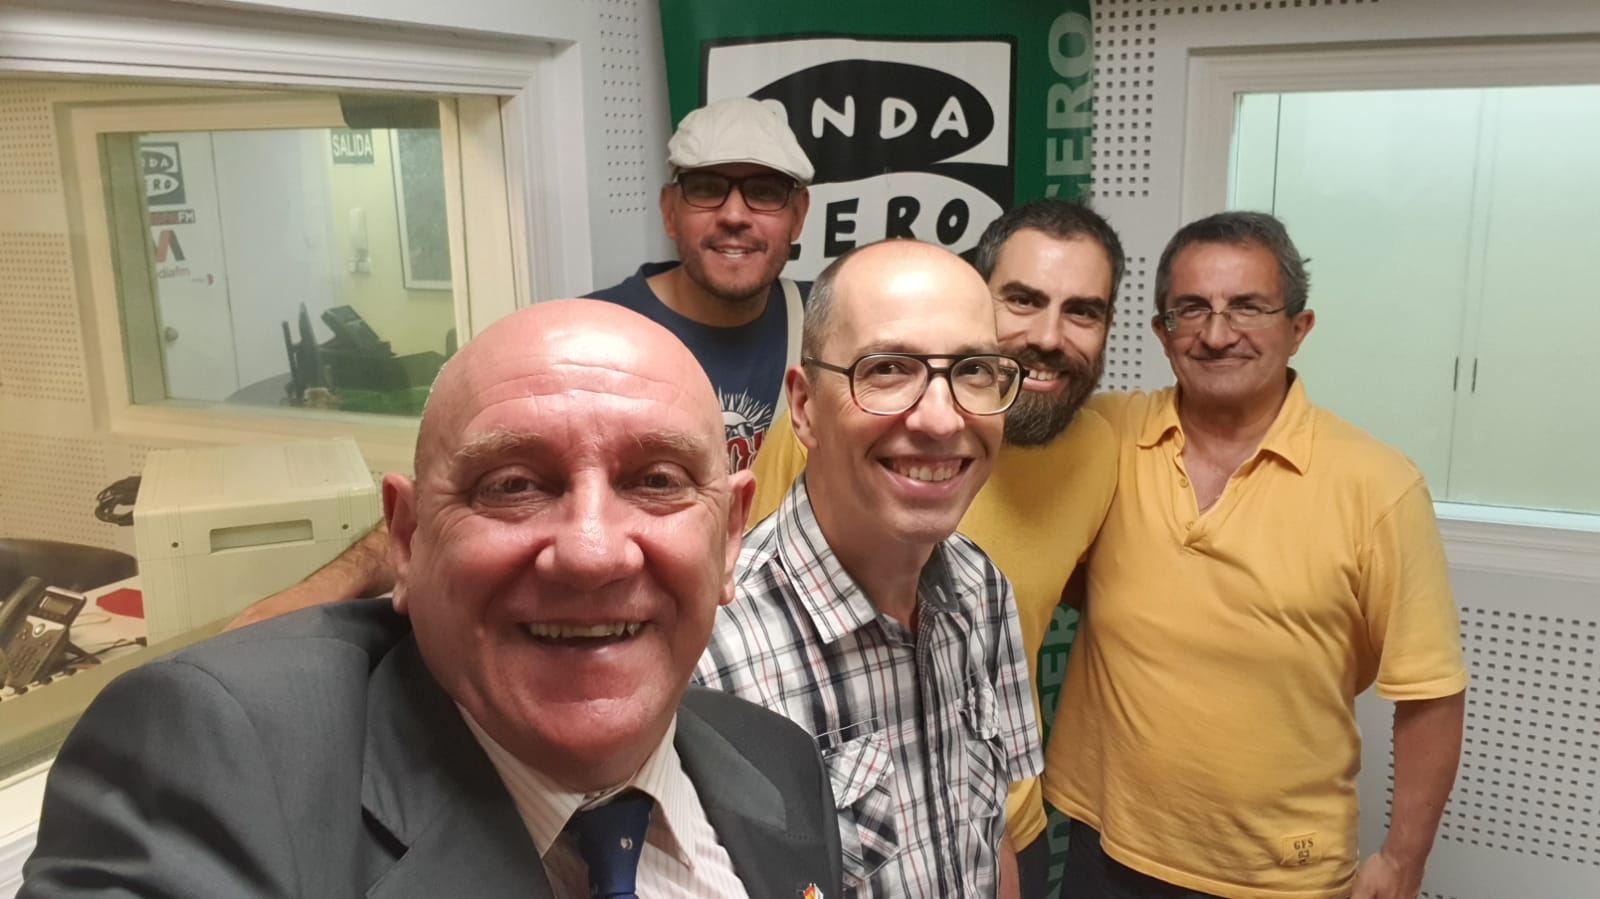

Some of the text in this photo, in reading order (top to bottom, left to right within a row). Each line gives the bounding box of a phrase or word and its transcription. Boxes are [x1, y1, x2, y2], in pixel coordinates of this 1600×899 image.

[811, 95, 969, 140] NDA
[333, 134, 373, 156] SALIDA
[789, 196, 969, 260] ERO
